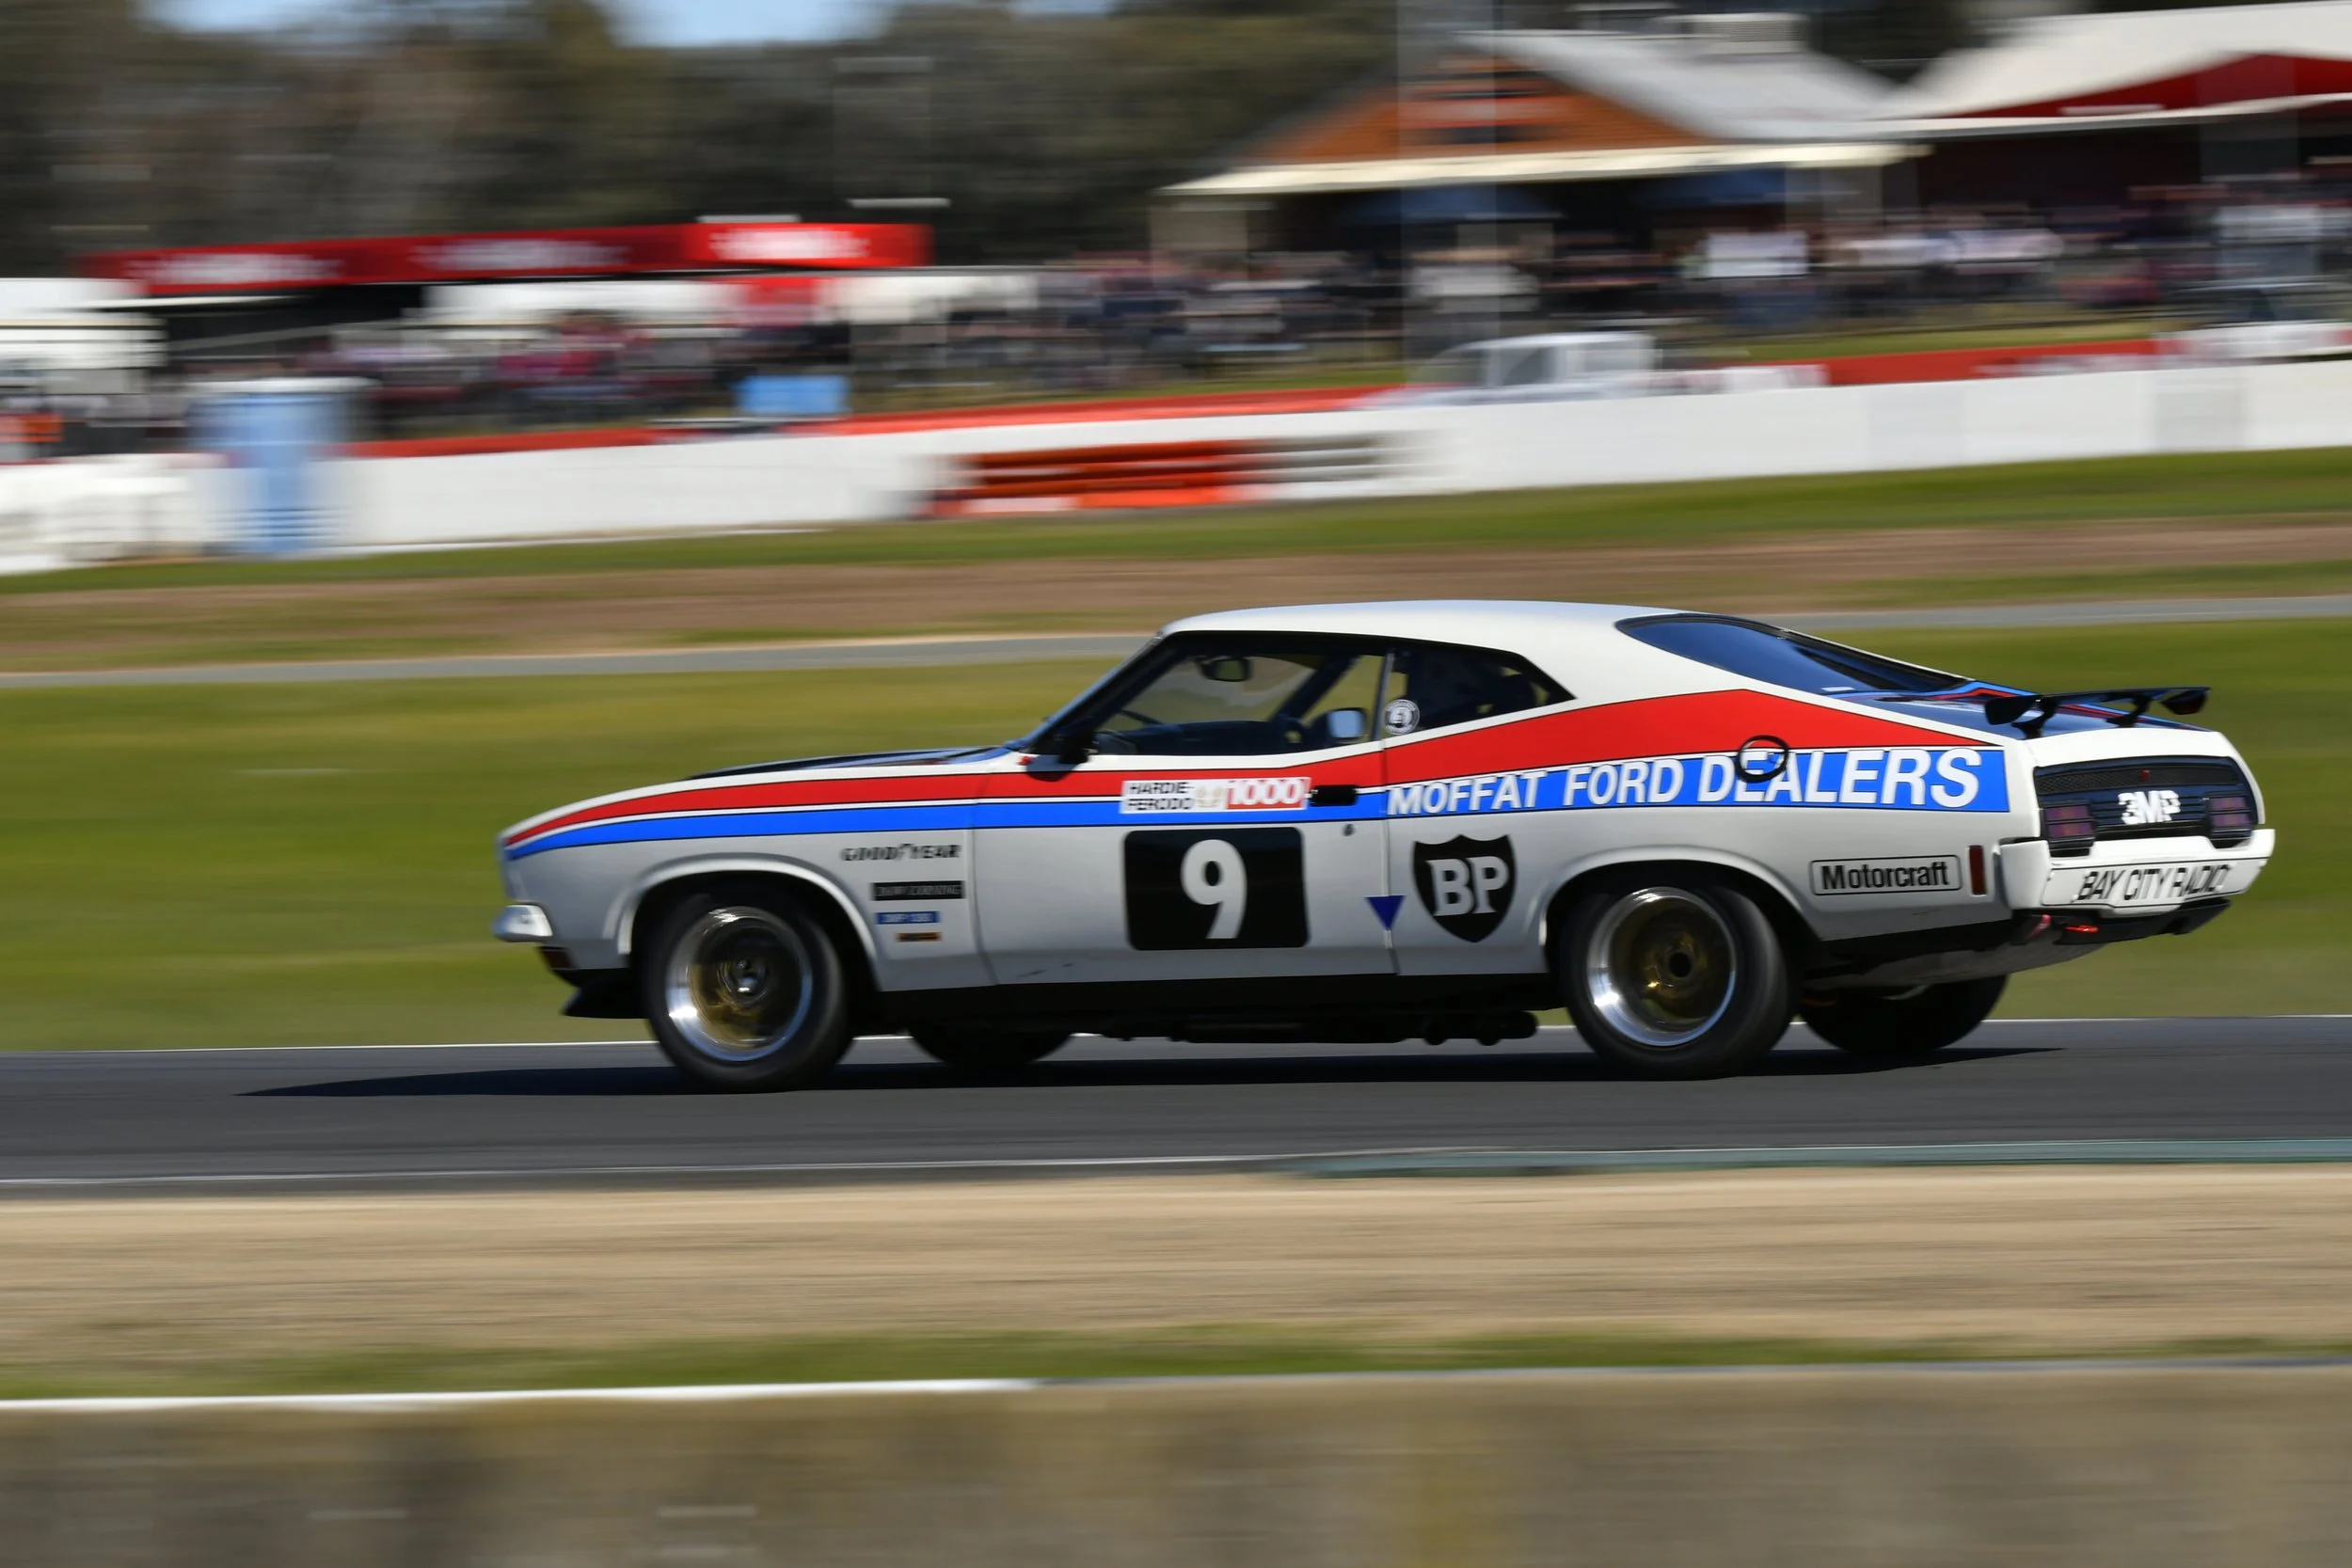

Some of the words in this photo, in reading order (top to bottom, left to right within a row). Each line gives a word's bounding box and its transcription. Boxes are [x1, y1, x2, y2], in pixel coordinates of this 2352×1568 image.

[1226, 779, 1305, 806] 1000
[1387, 770, 1544, 816] MOFFAT
[1562, 757, 1683, 806] FORD
[1697, 747, 1980, 807] DEALERS
[1181, 839, 1246, 939] 9
[1425, 857, 1509, 916] BP
[1821, 860, 1950, 891] Motorcraft
[2077, 870, 2125, 900] BAY
[2124, 868, 2168, 900] CITY
[2172, 864, 2230, 896] RADIO
